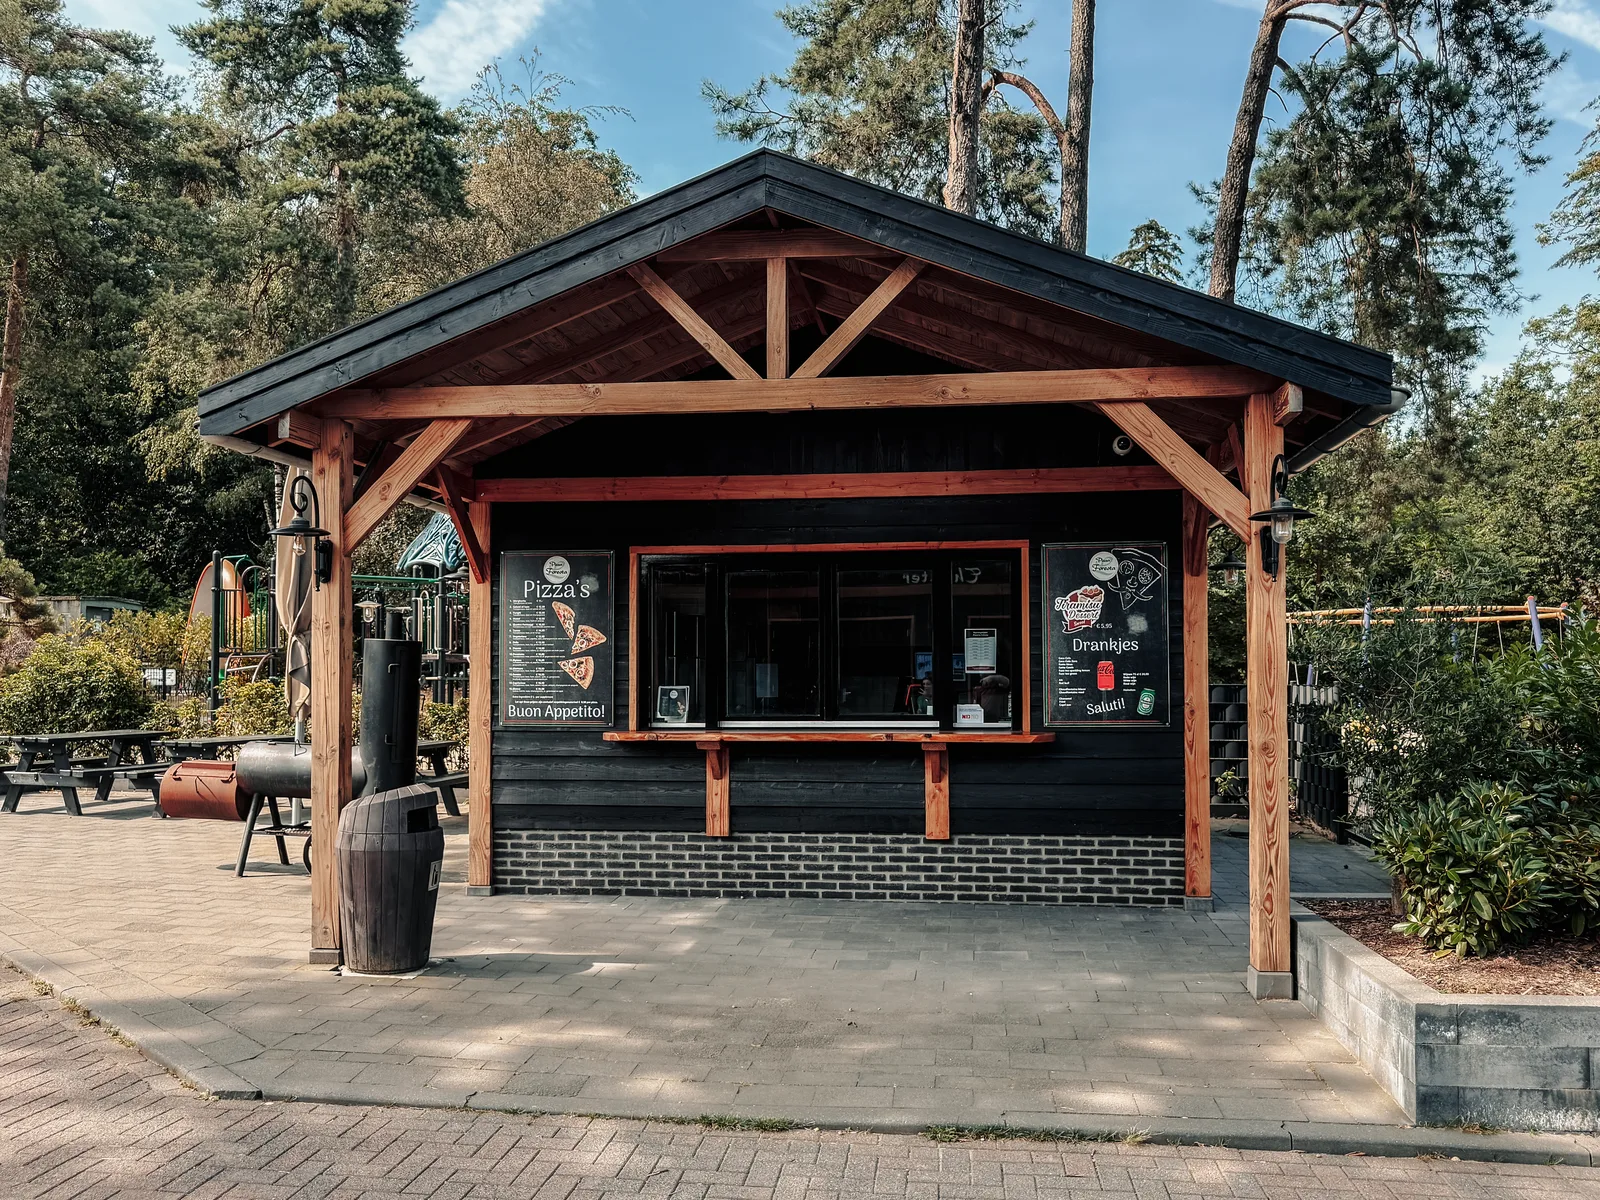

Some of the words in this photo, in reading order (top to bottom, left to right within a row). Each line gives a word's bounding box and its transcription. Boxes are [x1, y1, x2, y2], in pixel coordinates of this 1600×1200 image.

[524, 580, 590, 598] Pizza's
[1056, 598, 1101, 611] Tiramisu
[1068, 609, 1099, 619] Dessert
[1073, 638, 1139, 655] Drankjes
[508, 705, 542, 718] Buon
[544, 704, 605, 721] Appetito!
[1086, 697, 1126, 715] Saluti!
